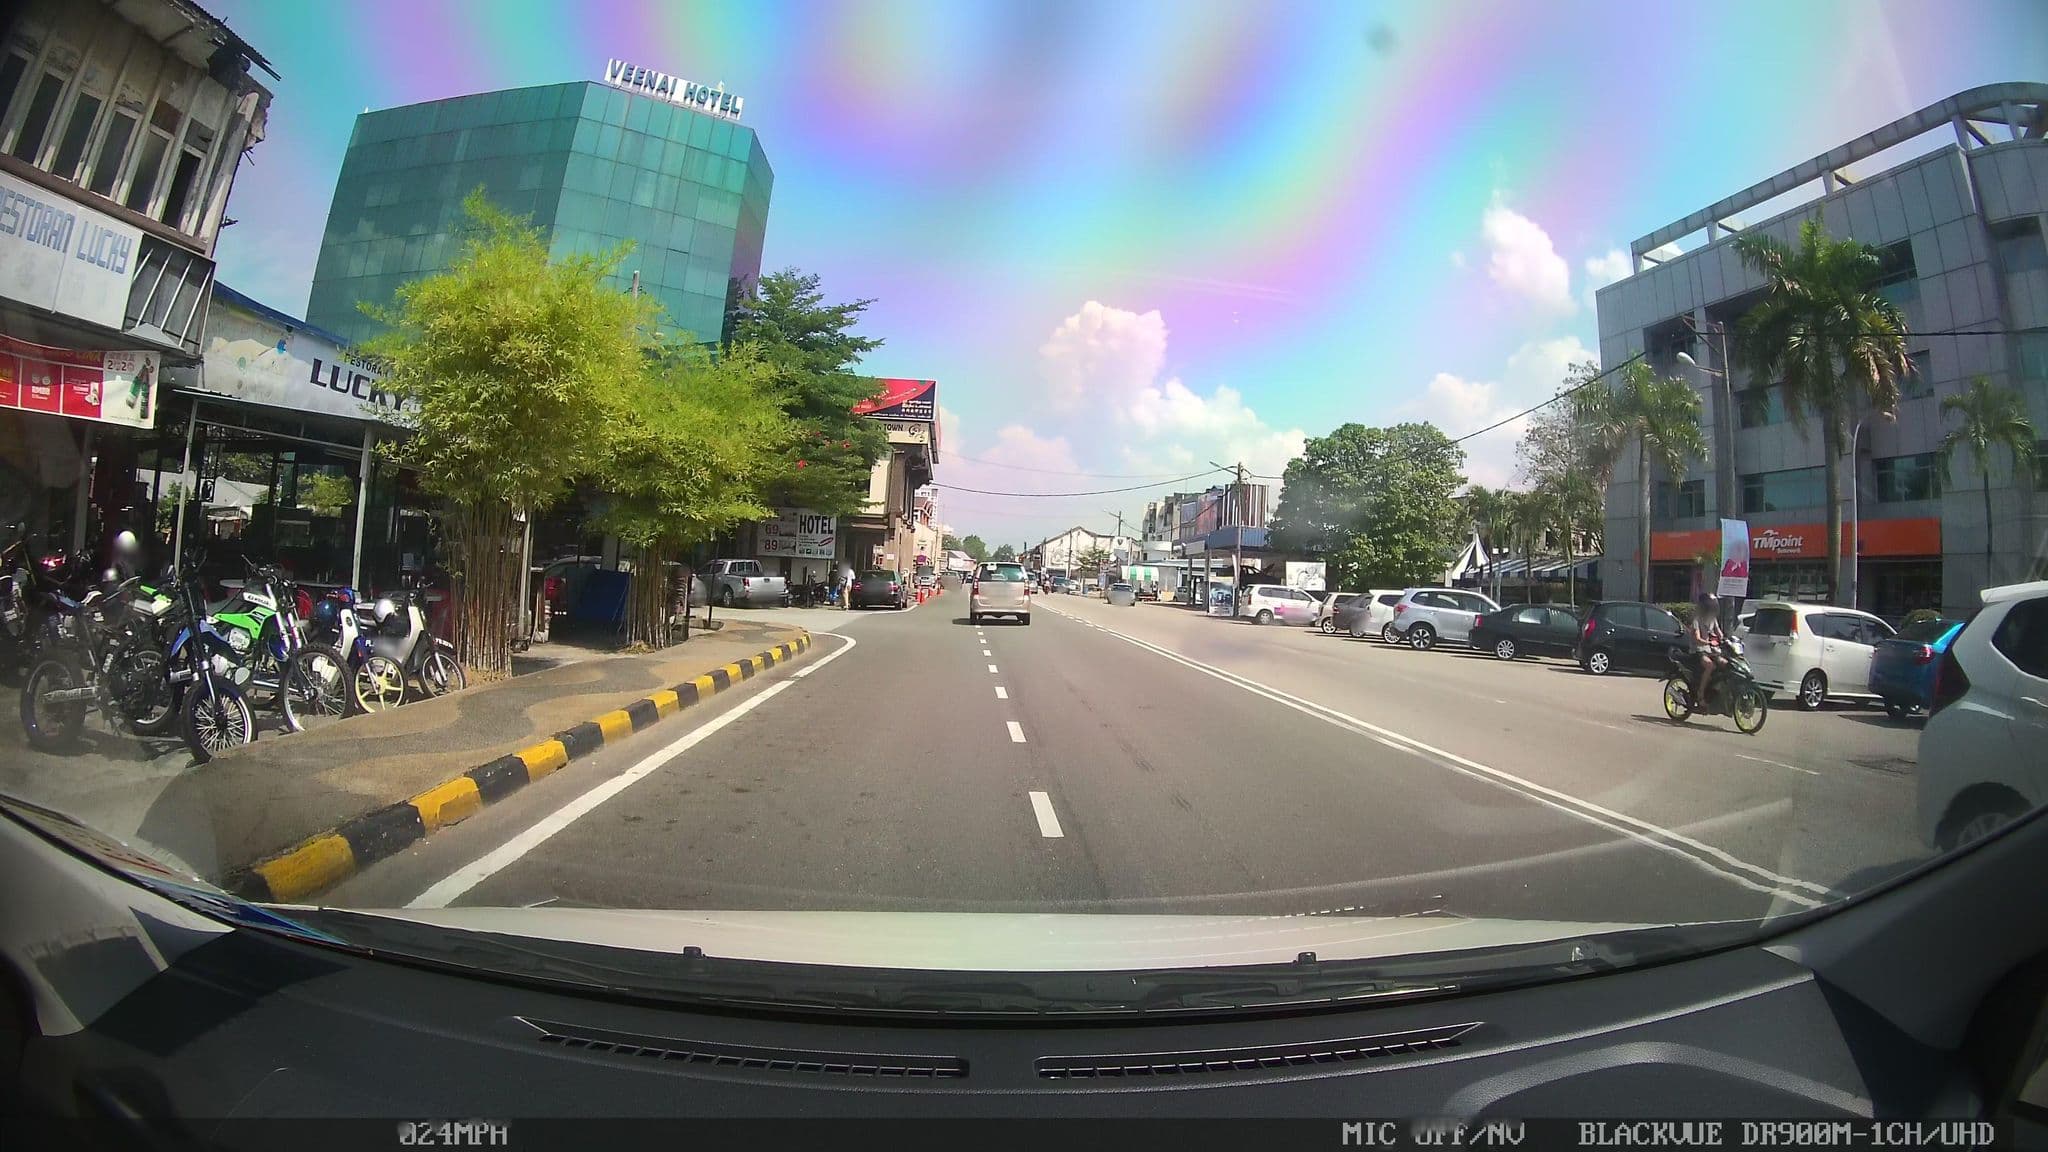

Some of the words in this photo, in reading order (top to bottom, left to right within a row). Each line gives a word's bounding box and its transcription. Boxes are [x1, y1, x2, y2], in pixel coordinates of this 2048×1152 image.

[610, 59, 678, 95] VEENAI
[684, 82, 741, 115] HOTEL
[76, 221, 133, 275] LUCKY
[884, 423, 904, 432] TOWN
[799, 514, 833, 534] HOTEL
[764, 539, 778, 551] 89
[1753, 534, 1804, 551] TMpoint
